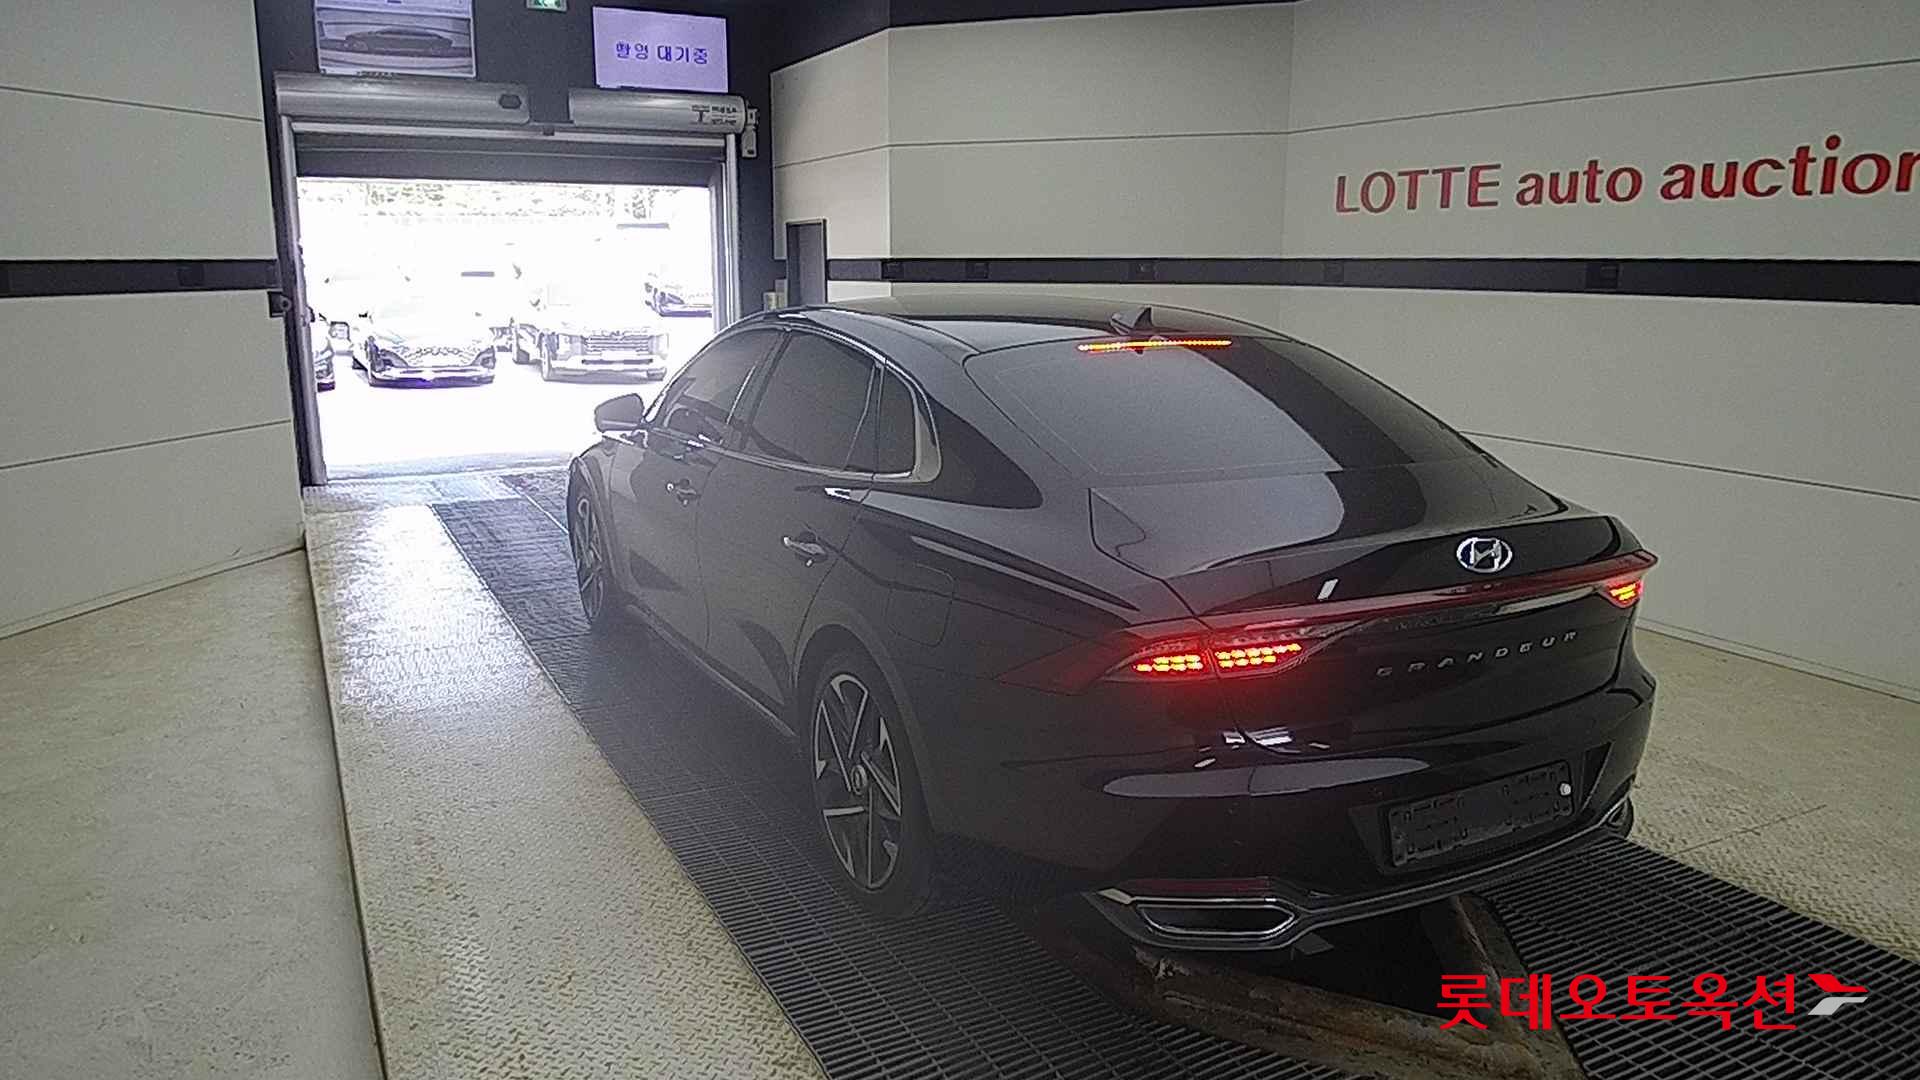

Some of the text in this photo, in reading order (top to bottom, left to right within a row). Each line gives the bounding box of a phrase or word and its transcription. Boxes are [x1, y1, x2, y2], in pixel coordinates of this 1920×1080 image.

[657, 45, 708, 65] 대기중
[1335, 163, 1502, 214] LOTTE
[1515, 159, 1643, 206] auto
[1375, 631, 1578, 678] GRANDEUR
